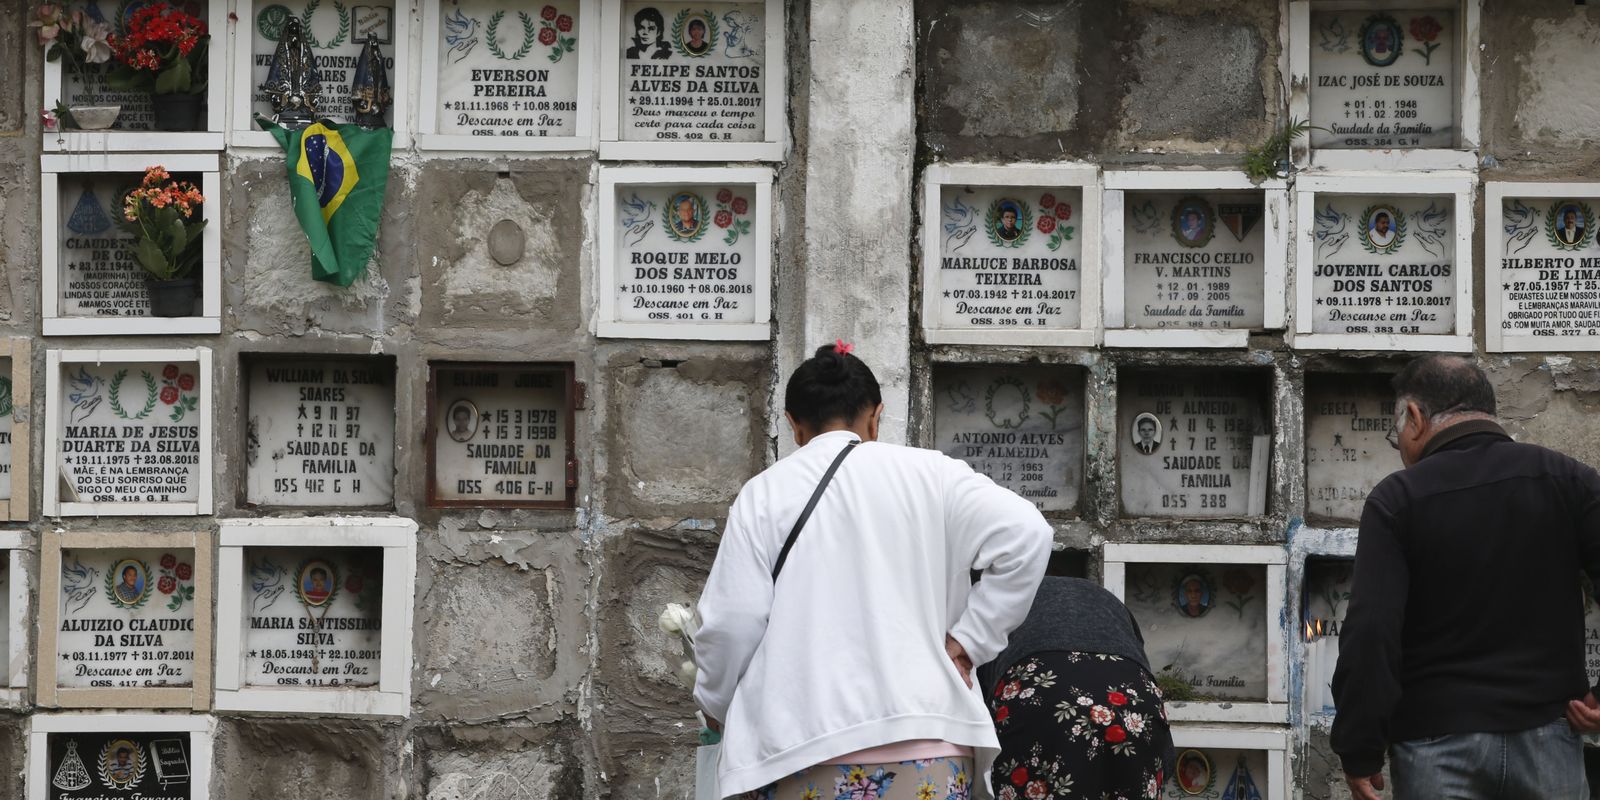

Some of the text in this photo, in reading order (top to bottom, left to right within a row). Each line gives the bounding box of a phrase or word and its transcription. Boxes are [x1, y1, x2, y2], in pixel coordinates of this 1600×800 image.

[471, 70, 549, 82] EVERSON
[630, 65, 760, 78] FELIPE SANTOS
[630, 80, 760, 93] ALVES DA SILVA
[1318, 73, 1444, 90] IZAC JOSÉ DE SOUZA
[473, 85, 547, 97] PEREIRA
[454, 101, 509, 111] 21.11.1968
[639, 96, 762, 107] 29.11.1994 25.01.2017
[457, 113, 563, 126] Descanse em Paz
[632, 107, 661, 117] Deus
[720, 109, 755, 121] tempo
[664, 122, 692, 130] para
[696, 120, 724, 129] cada
[728, 120, 756, 129] coisa
[1331, 123, 1374, 135] Saudade
[1377, 123, 1390, 135] da
[631, 252, 741, 265] ROQUE MELO
[941, 258, 1077, 271] MARLUCE BARBOSA
[1134, 253, 1254, 264] FRANCISCO CELIO
[635, 268, 738, 280] DOS SANTOS
[1156, 267, 1231, 278] V. MARTINS
[1314, 264, 1451, 277] JOVENIL CARLOS
[1539, 270, 1559, 281] DE
[975, 273, 1042, 286] TEIXEIRA
[632, 285, 753, 294] 10.10.1960 08.06.2018
[1333, 280, 1433, 292] DOS SANTOS
[1514, 282, 1570, 291] 27.05.1957
[94, 291, 110, 299] QUE
[112, 291, 139, 299] JAMAIS
[953, 290, 1076, 300] 07.03.1942 21.04.2017
[1509, 292, 1597, 300] DEIXASTES LUZ EM NOSSOS
[114, 299, 134, 308] VOCÊ
[633, 296, 739, 309] Descanse em Paz
[1326, 297, 1451, 306] 09.11.1978 12.10.2017
[1524, 301, 1569, 311] LEMBRANÇAS
[956, 302, 1062, 315] Descanse em Paz
[1144, 305, 1187, 317] Saudade
[1190, 305, 1202, 317] da
[1329, 309, 1437, 321] Descanse em Paz
[1559, 311, 1577, 319] TUDO
[1578, 311, 1592, 319] QUE
[1515, 321, 1529, 329] COM
[300, 387, 345, 402] SOARES
[515, 410, 522, 423] 3
[528, 410, 557, 424] 1978
[66, 426, 198, 439] MARIA DE JESUS
[515, 426, 522, 440] 3
[528, 426, 557, 440] 1998
[953, 433, 1064, 445] ANTONIO ALVES
[62, 441, 200, 453] DUARTE DA SILVA
[287, 442, 376, 456] SAUDADE DA
[466, 444, 551, 458] SAUDADE DA
[988, 447, 1048, 458] ALMEIDA
[76, 455, 199, 465] 19.11.1975 23.08.2018
[1163, 456, 1221, 470] SAUDADE
[100, 465, 107, 474] É
[126, 467, 189, 476] LEMBRANÇA
[302, 460, 357, 474] FAMILIA
[485, 461, 536, 475] FAMILIA
[118, 476, 163, 484] SORRISO
[166, 476, 187, 484] QUE
[305, 479, 324, 493] 412
[1181, 474, 1231, 488] FAMILIA
[78, 486, 102, 494] SIGO
[105, 486, 113, 494] O
[139, 486, 187, 494] CAMINHO
[496, 481, 522, 495] 406
[61, 619, 123, 632] ALUIZIO
[251, 617, 294, 629] MARIA
[94, 635, 163, 647] DA SILVA
[72, 652, 128, 661] 03.11.1977
[261, 650, 314, 659] 18.05.1943
[75, 664, 182, 677] Descanse em Paz
[322, 666, 339, 675] em
[343, 662, 368, 675] Paz
